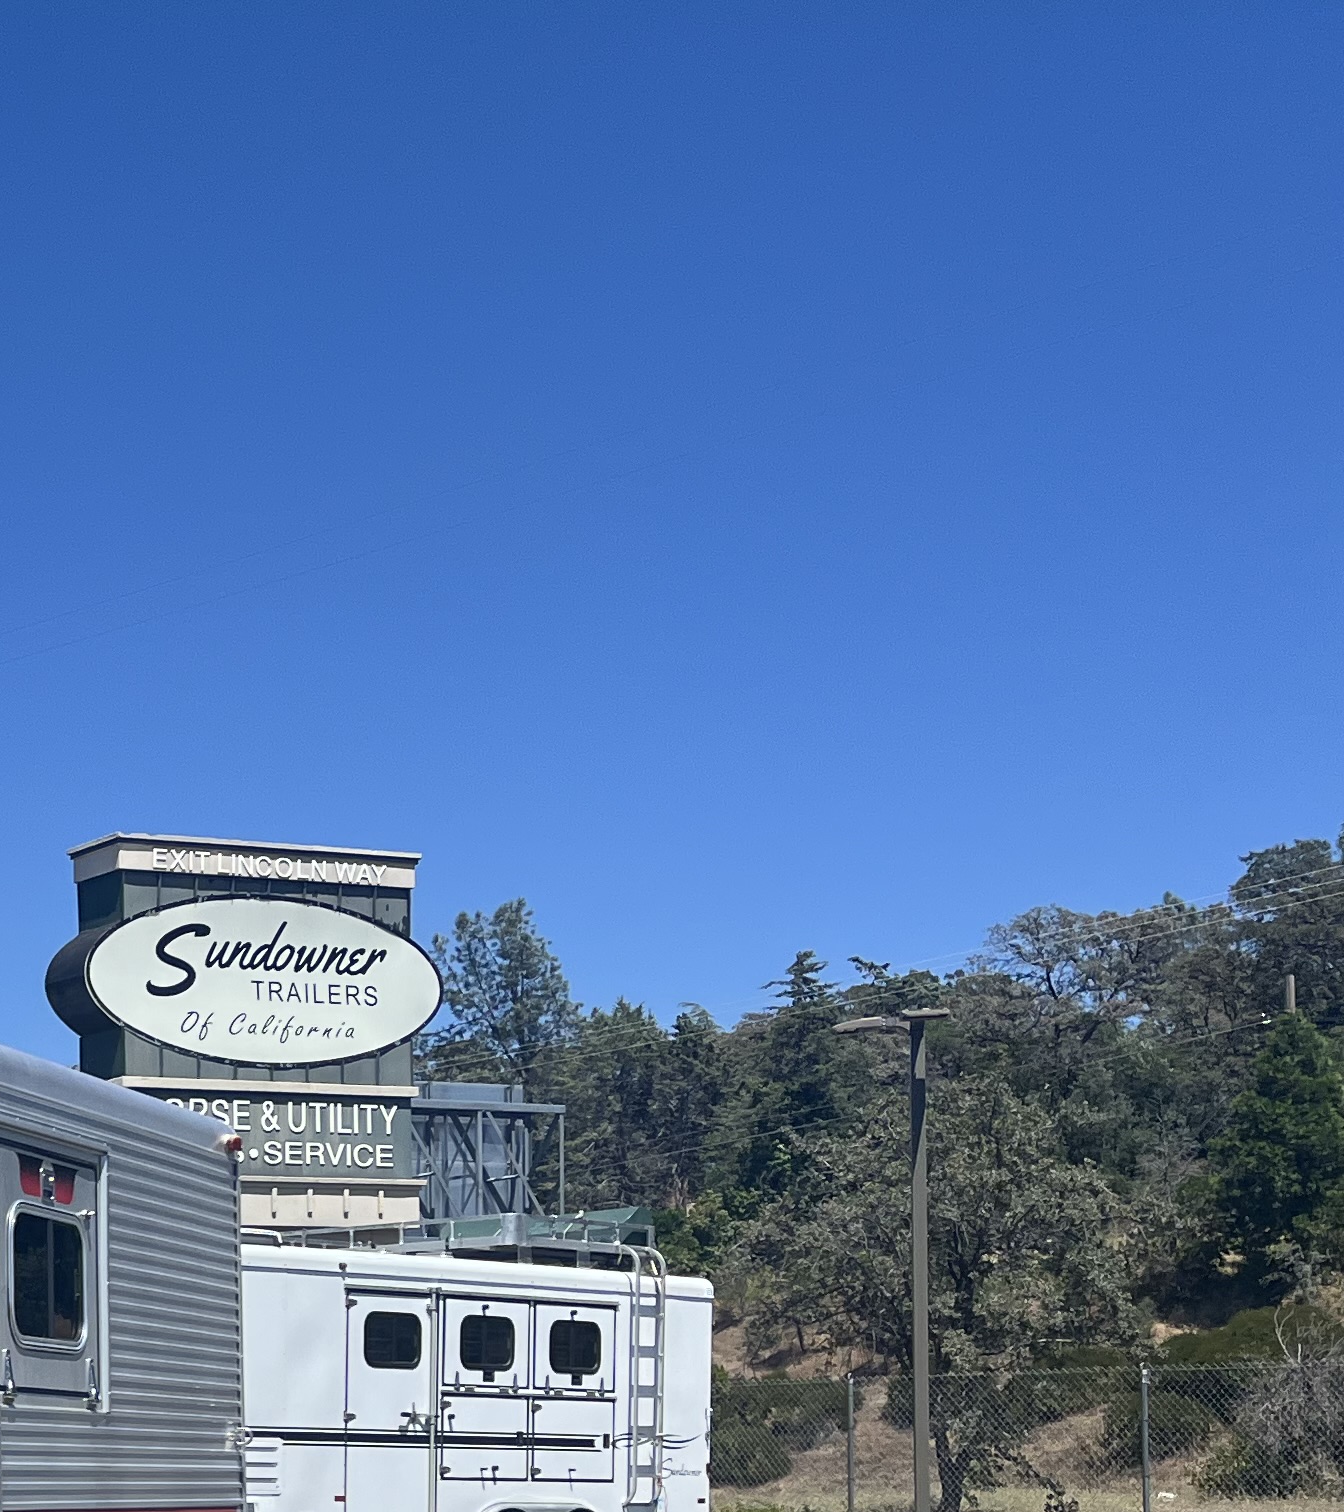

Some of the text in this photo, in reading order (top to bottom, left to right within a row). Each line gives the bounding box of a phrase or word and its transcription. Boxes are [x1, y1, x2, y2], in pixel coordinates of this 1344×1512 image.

[152, 848, 388, 884] EXIT LINCOLN WAY
[146, 921, 387, 997] Sundowner
[251, 980, 379, 1007] TRAILERS
[180, 1011, 355, 1044] Of California
[260, 1100, 281, 1132] &
[287, 1101, 399, 1135] UTILITY
[263, 1140, 395, 1167] SERVICE
